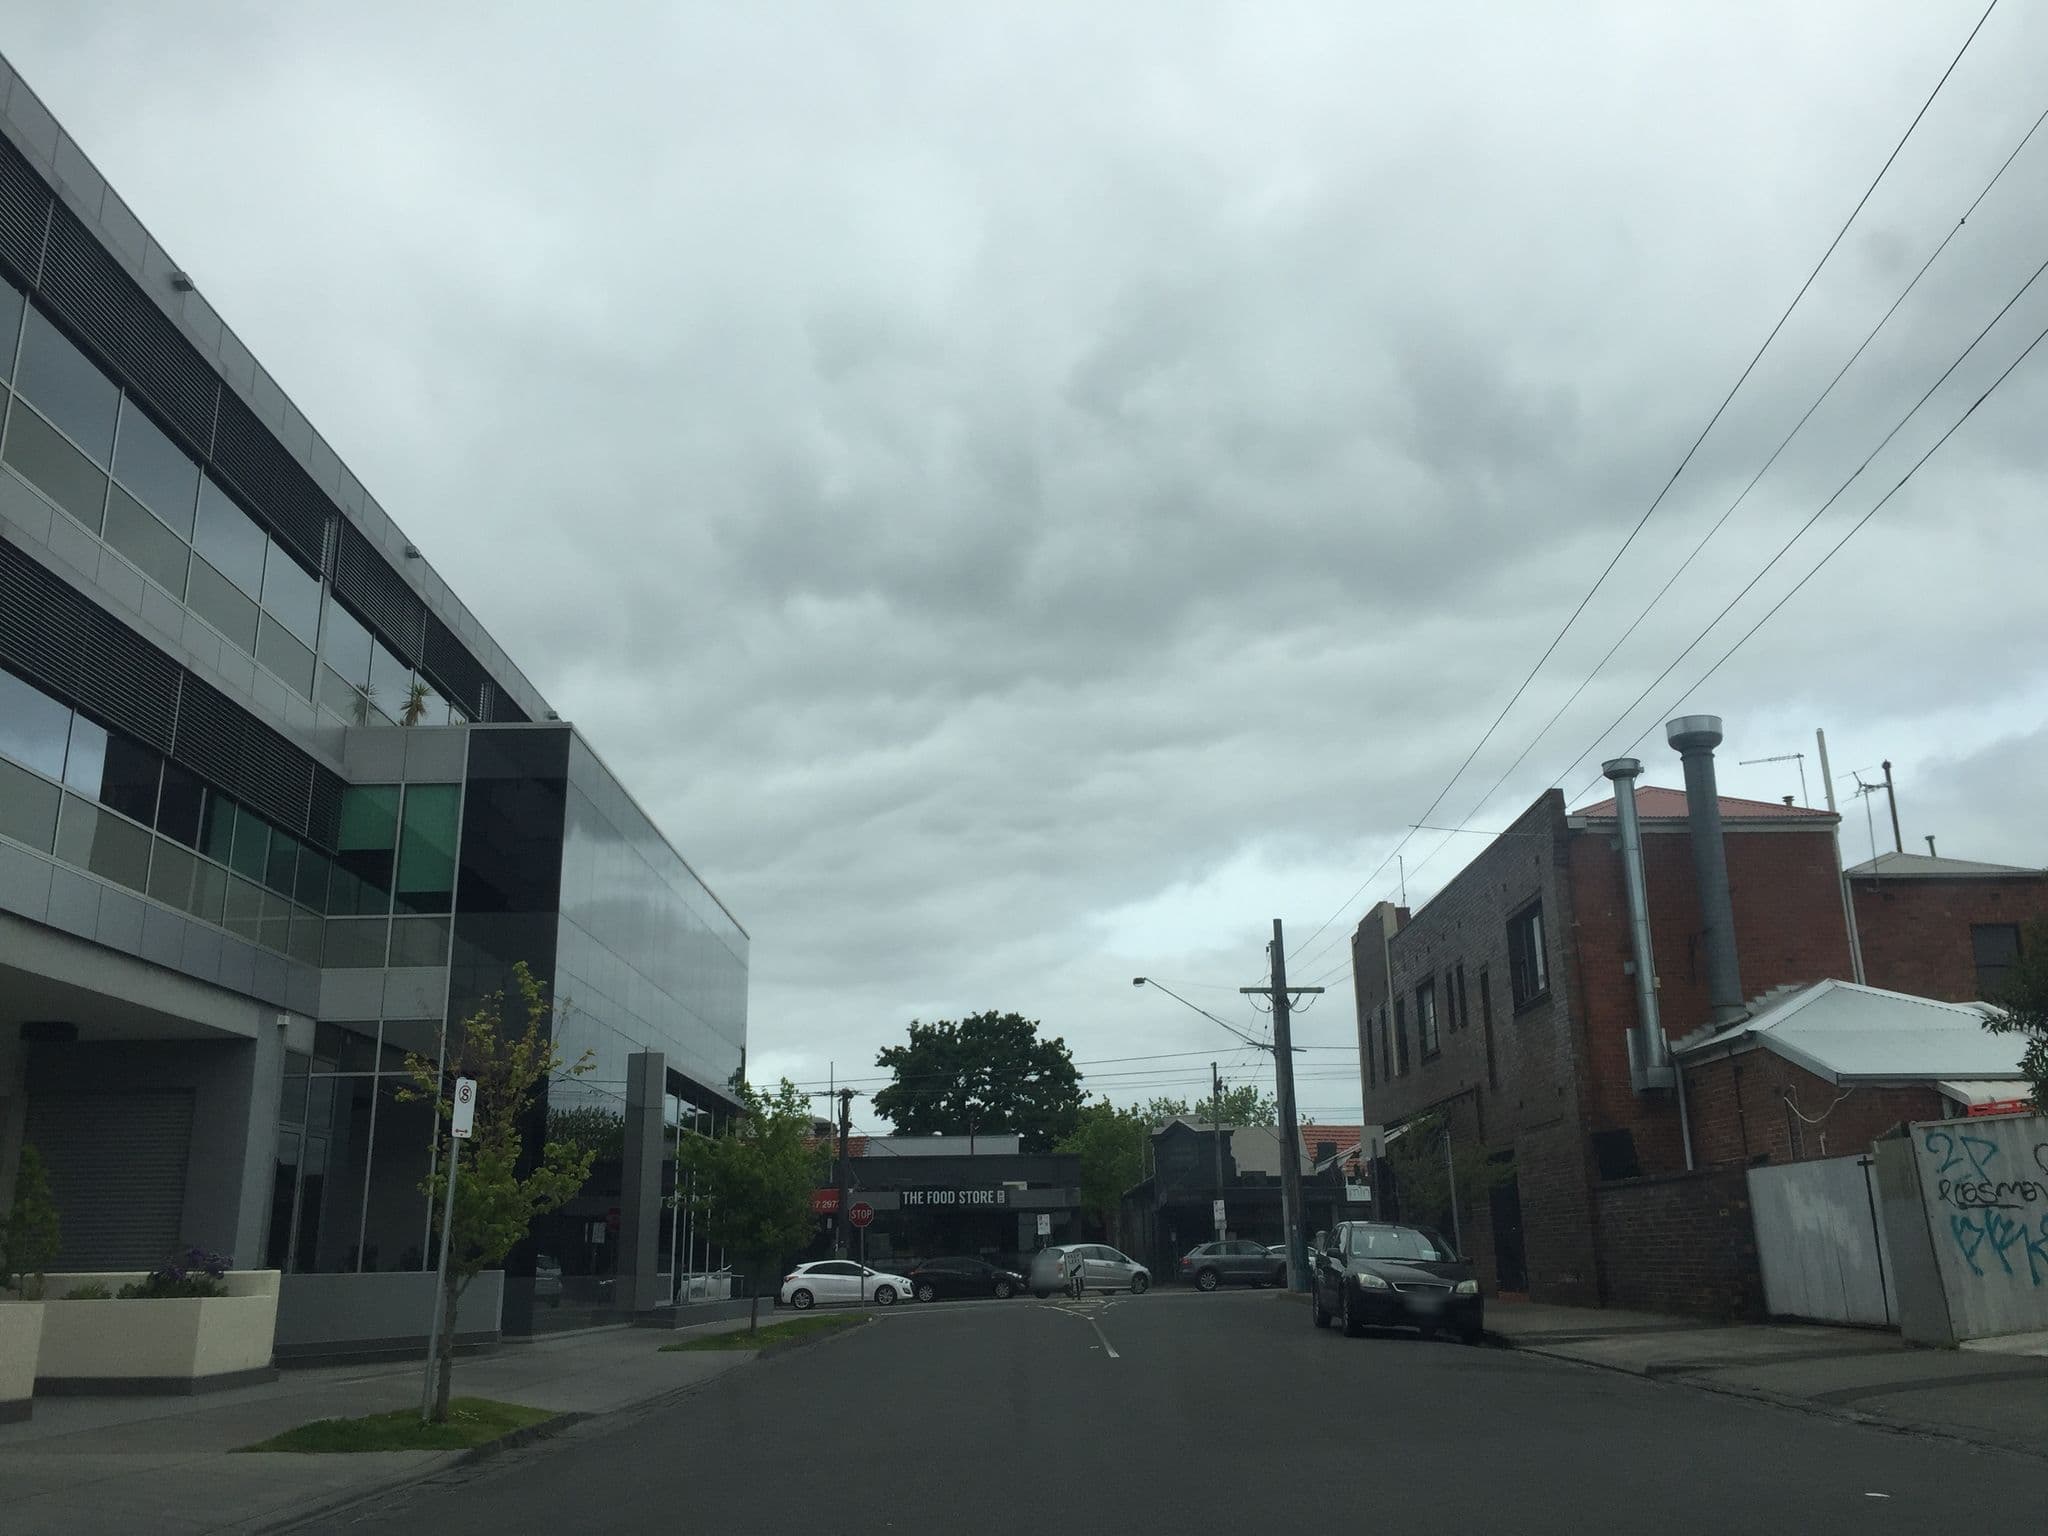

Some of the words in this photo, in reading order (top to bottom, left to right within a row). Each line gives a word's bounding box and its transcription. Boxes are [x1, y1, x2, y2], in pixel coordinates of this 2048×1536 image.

[903, 1191, 924, 1205] THE
[927, 1190, 955, 1204] FOOD
[959, 1190, 994, 1204] STORE
[851, 1209, 872, 1219] STOP
